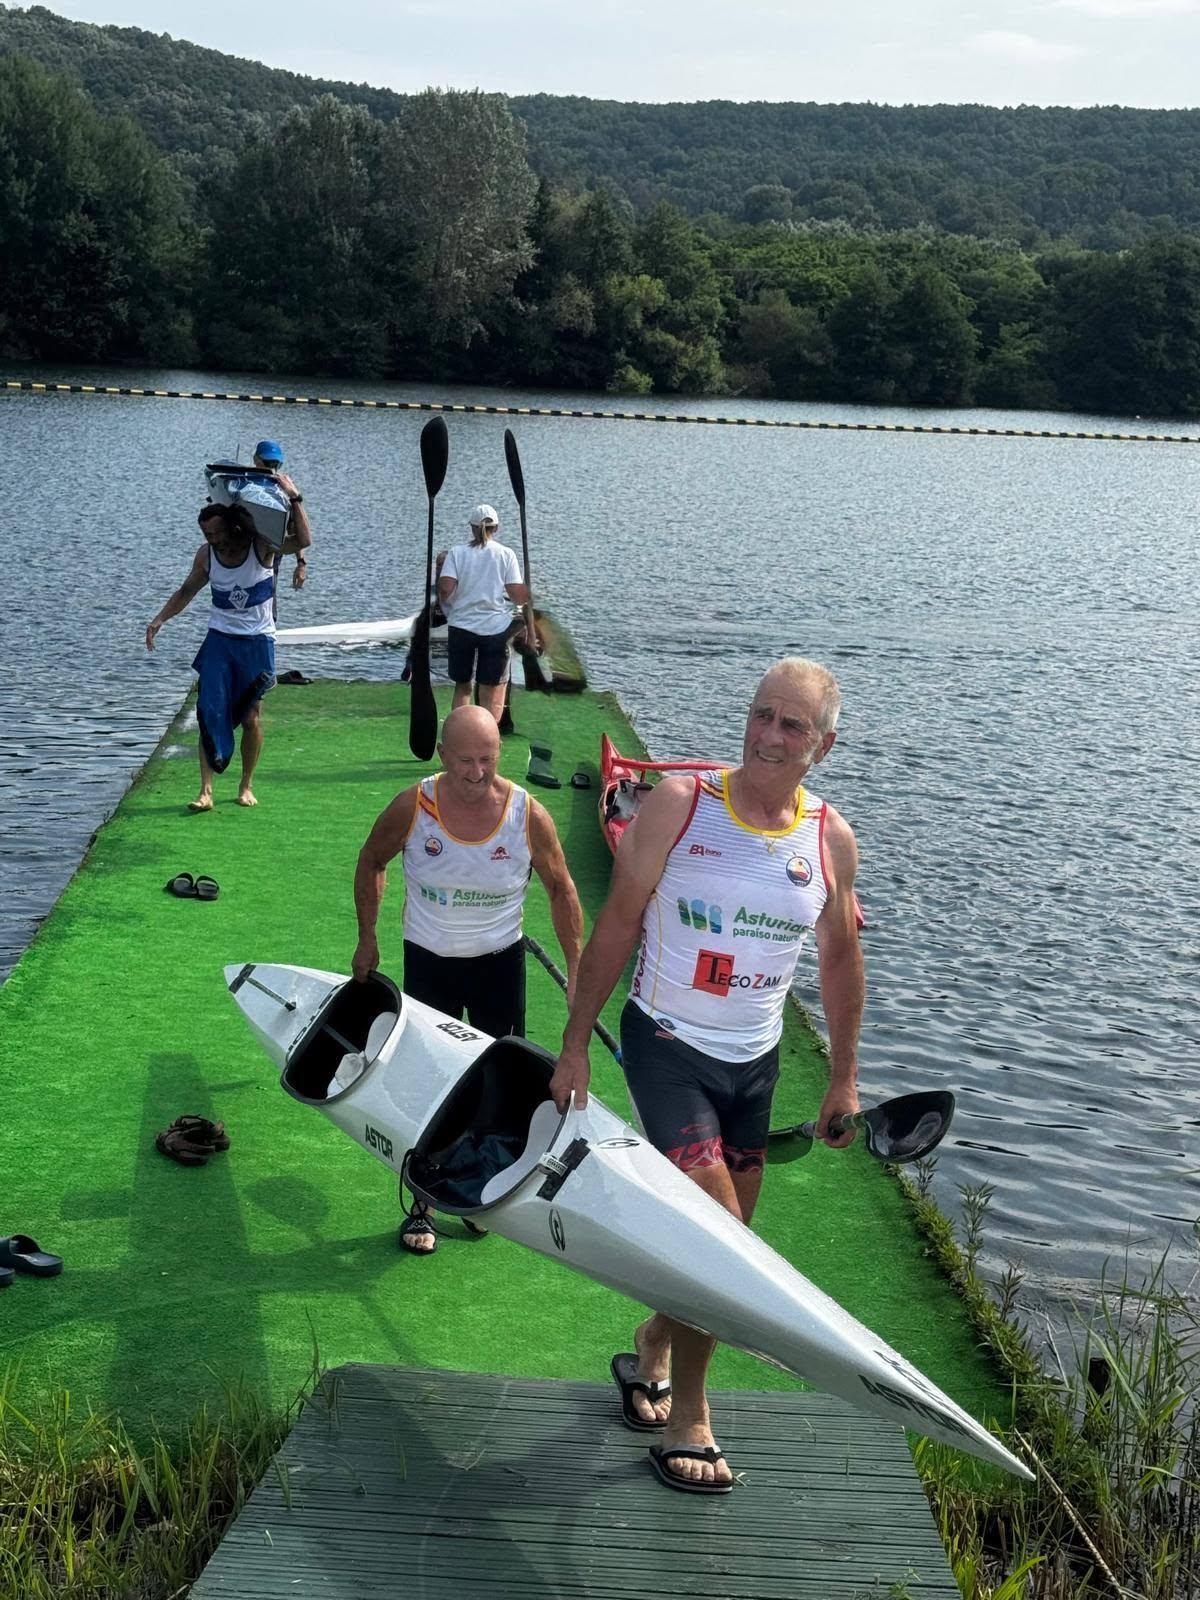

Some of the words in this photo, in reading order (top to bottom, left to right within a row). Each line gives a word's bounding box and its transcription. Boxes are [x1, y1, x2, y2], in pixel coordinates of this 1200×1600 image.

[733, 927, 771, 939] paraíso
[365, 1123, 394, 1163] ASTOR
[857, 1374, 984, 1446] ASTOR
